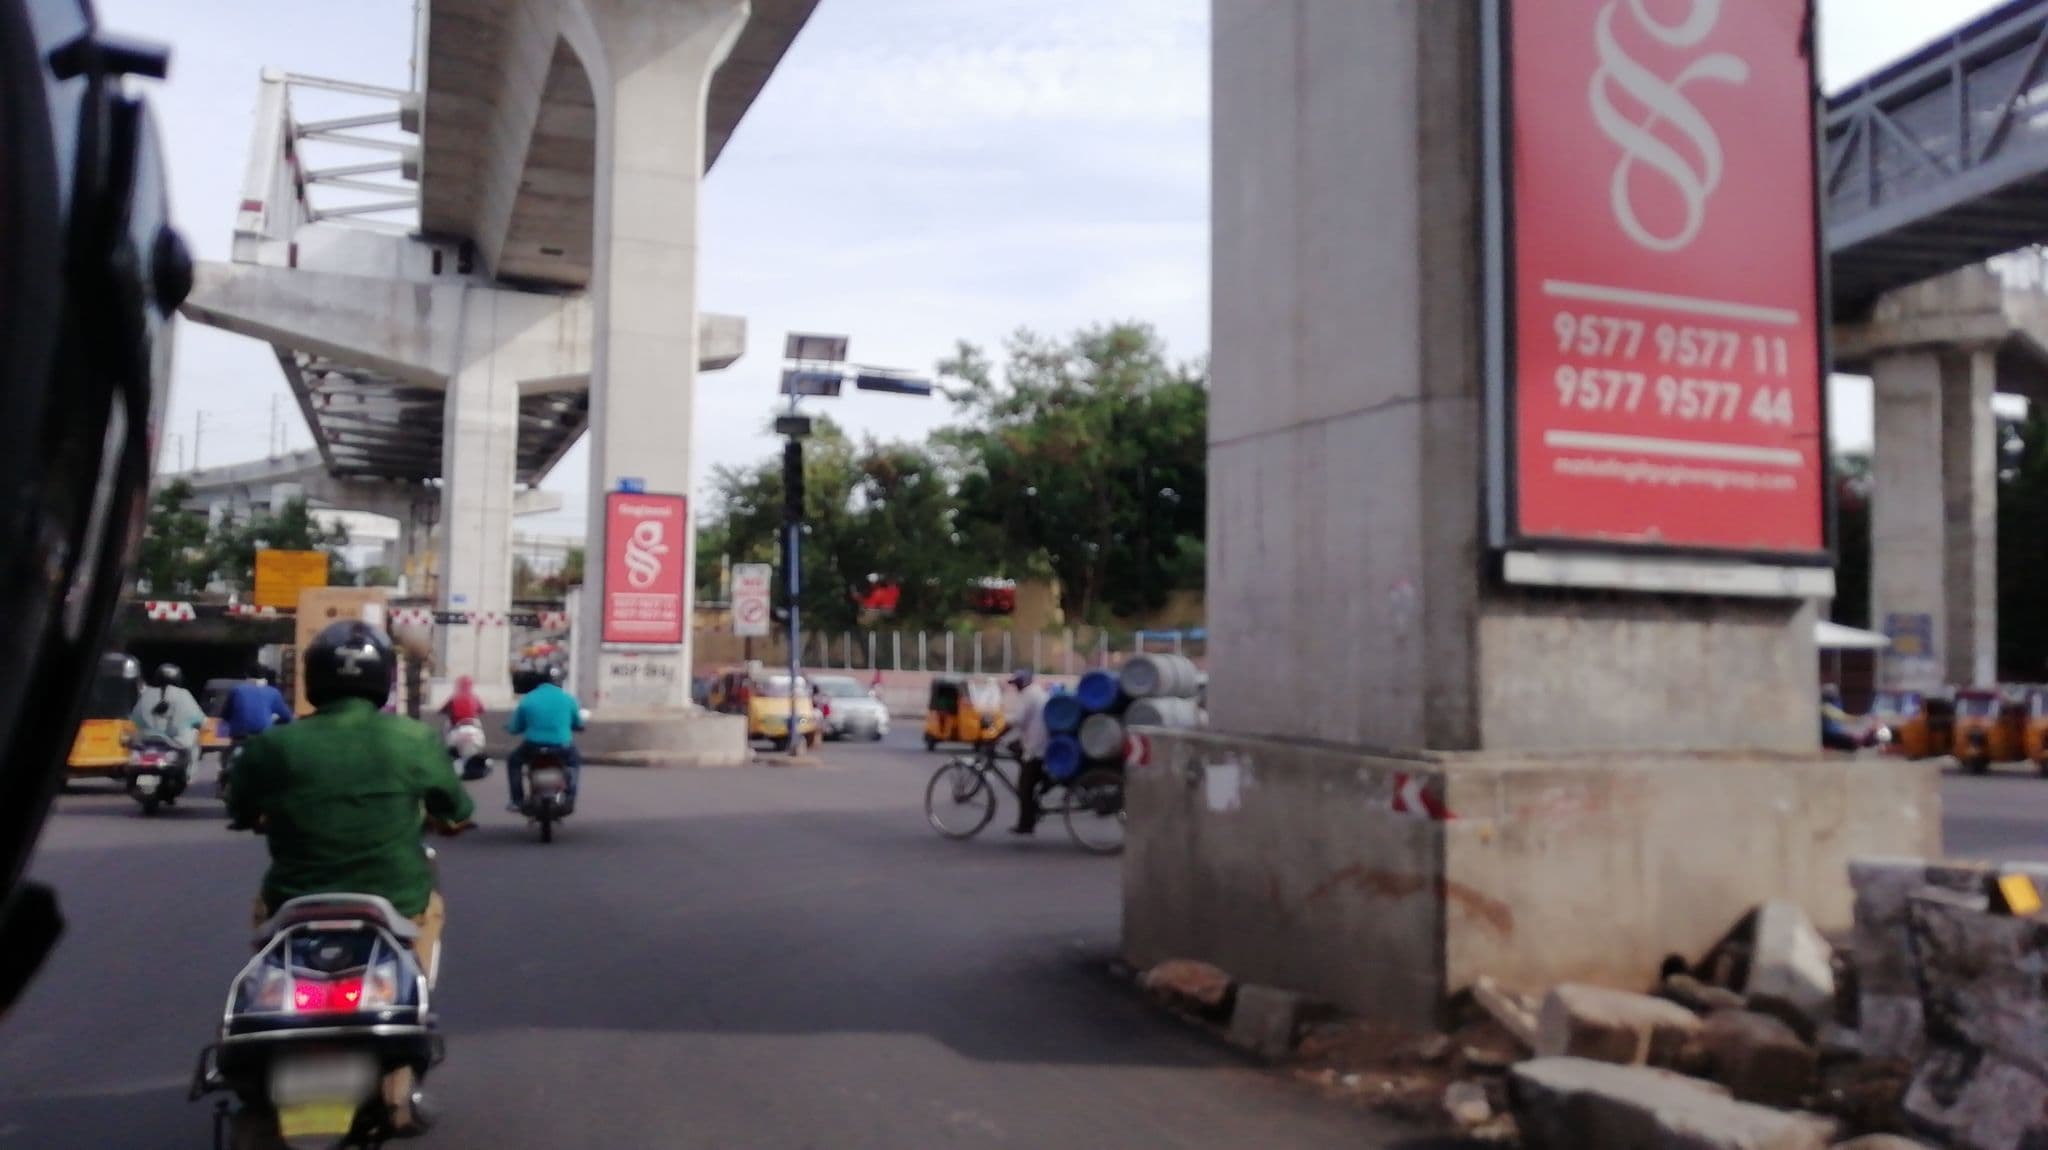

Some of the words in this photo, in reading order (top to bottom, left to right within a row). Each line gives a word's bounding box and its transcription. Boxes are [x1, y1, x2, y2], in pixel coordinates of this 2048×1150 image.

[1554, 311, 1644, 360] 9577
[1655, 324, 1740, 369] 9577
[1751, 336, 1788, 376] 11
[1554, 365, 1647, 412] 9577
[1656, 376, 1742, 421] 9577
[1750, 386, 1794, 427] 44
